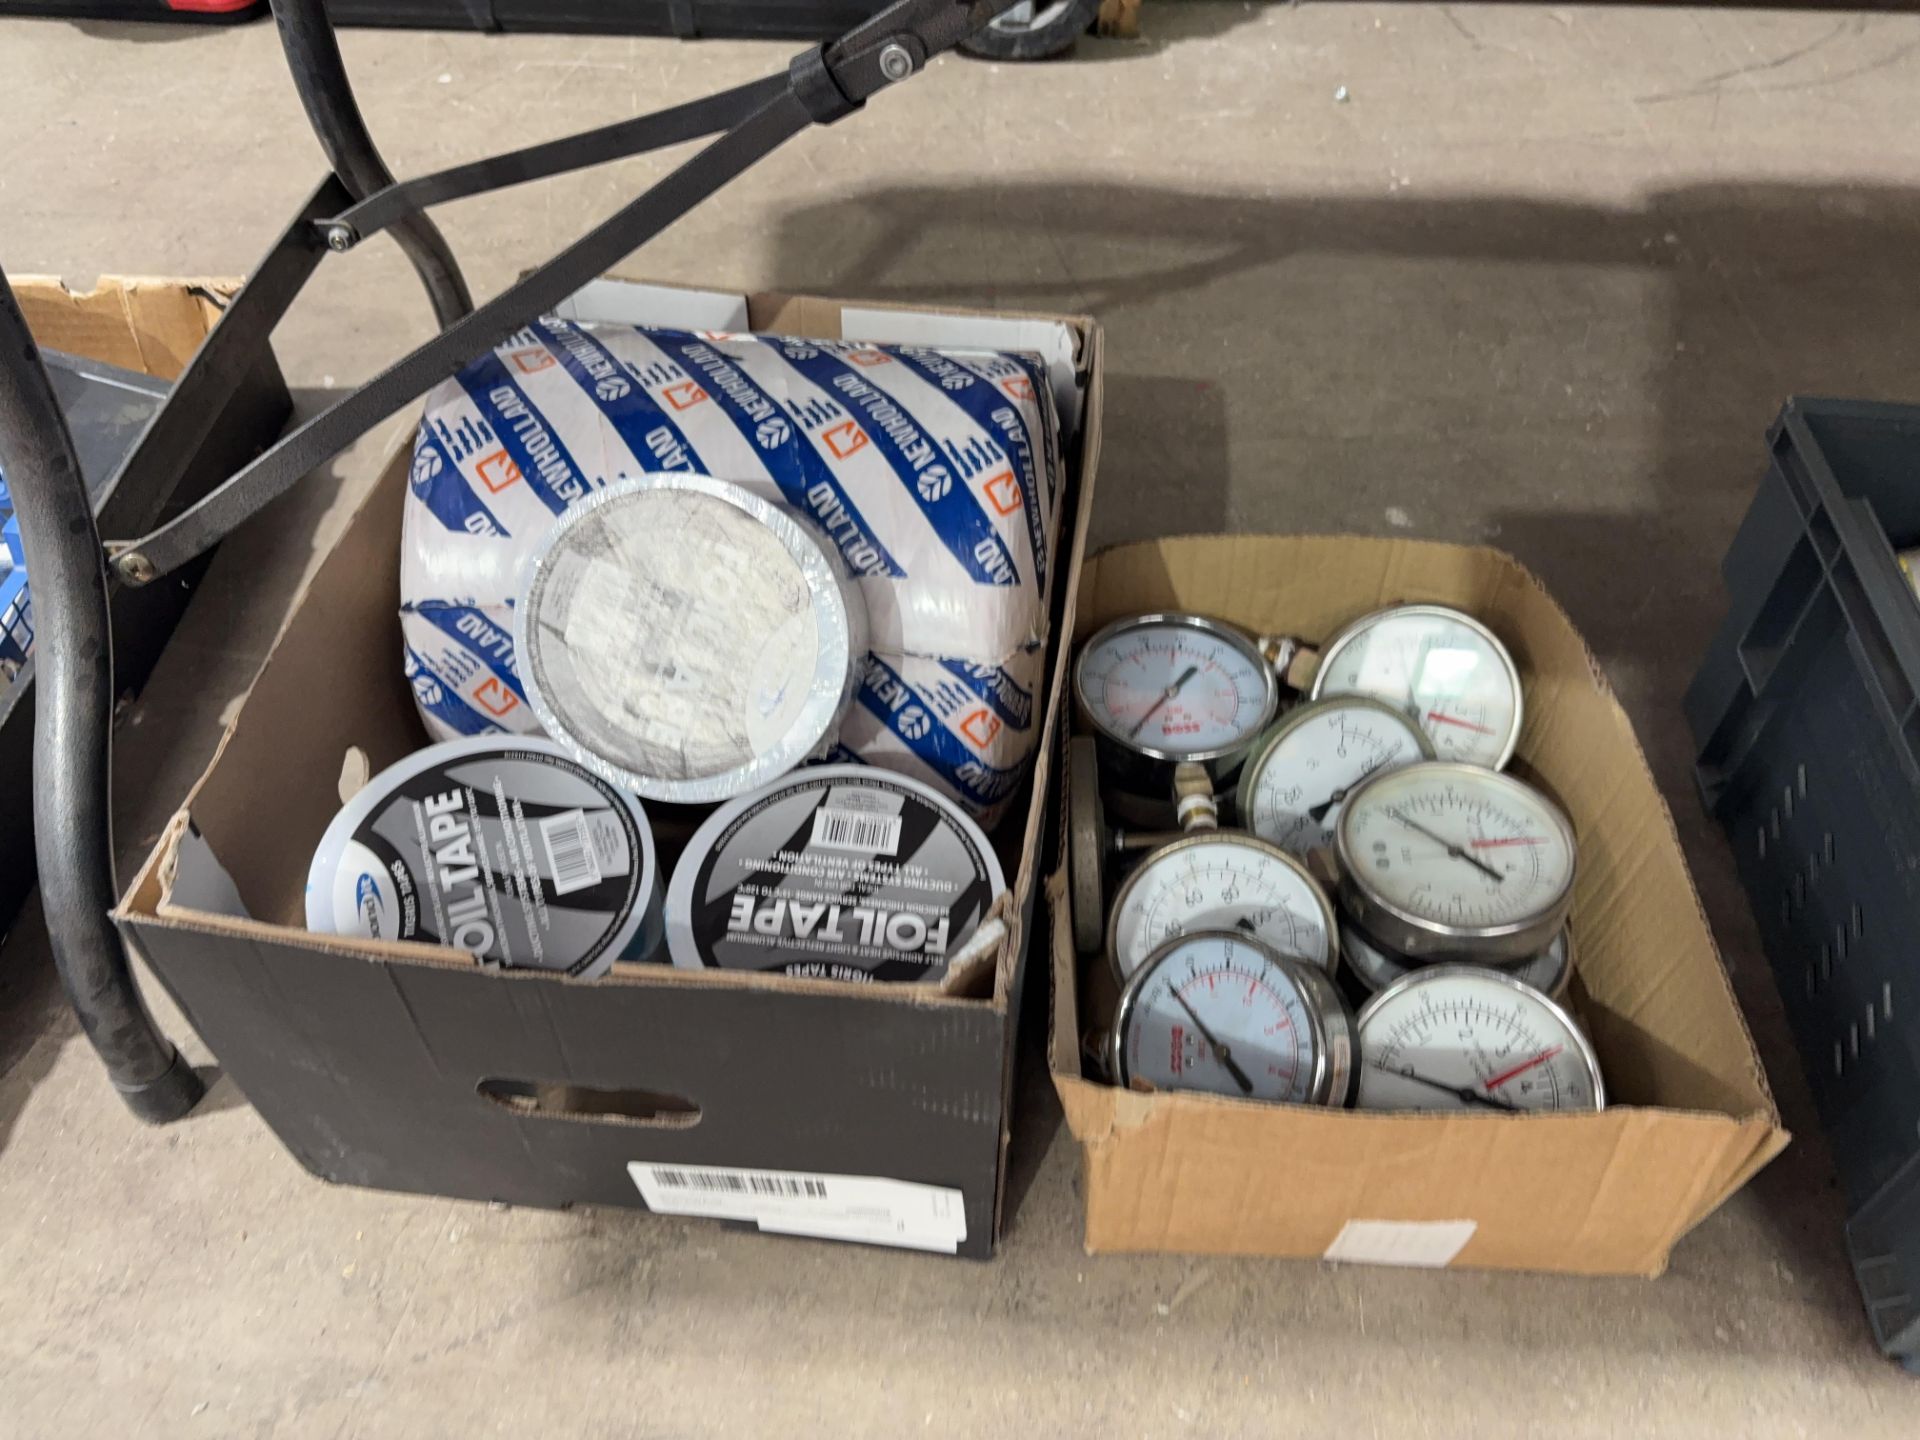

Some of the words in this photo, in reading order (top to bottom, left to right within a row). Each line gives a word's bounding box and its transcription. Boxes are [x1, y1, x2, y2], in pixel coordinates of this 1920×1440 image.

[833, 373, 937, 470] NEWHOLLAND
[424, 788, 479, 893] TAPE
[727, 893, 844, 942] TAPE
[853, 906, 950, 954] FOIL
